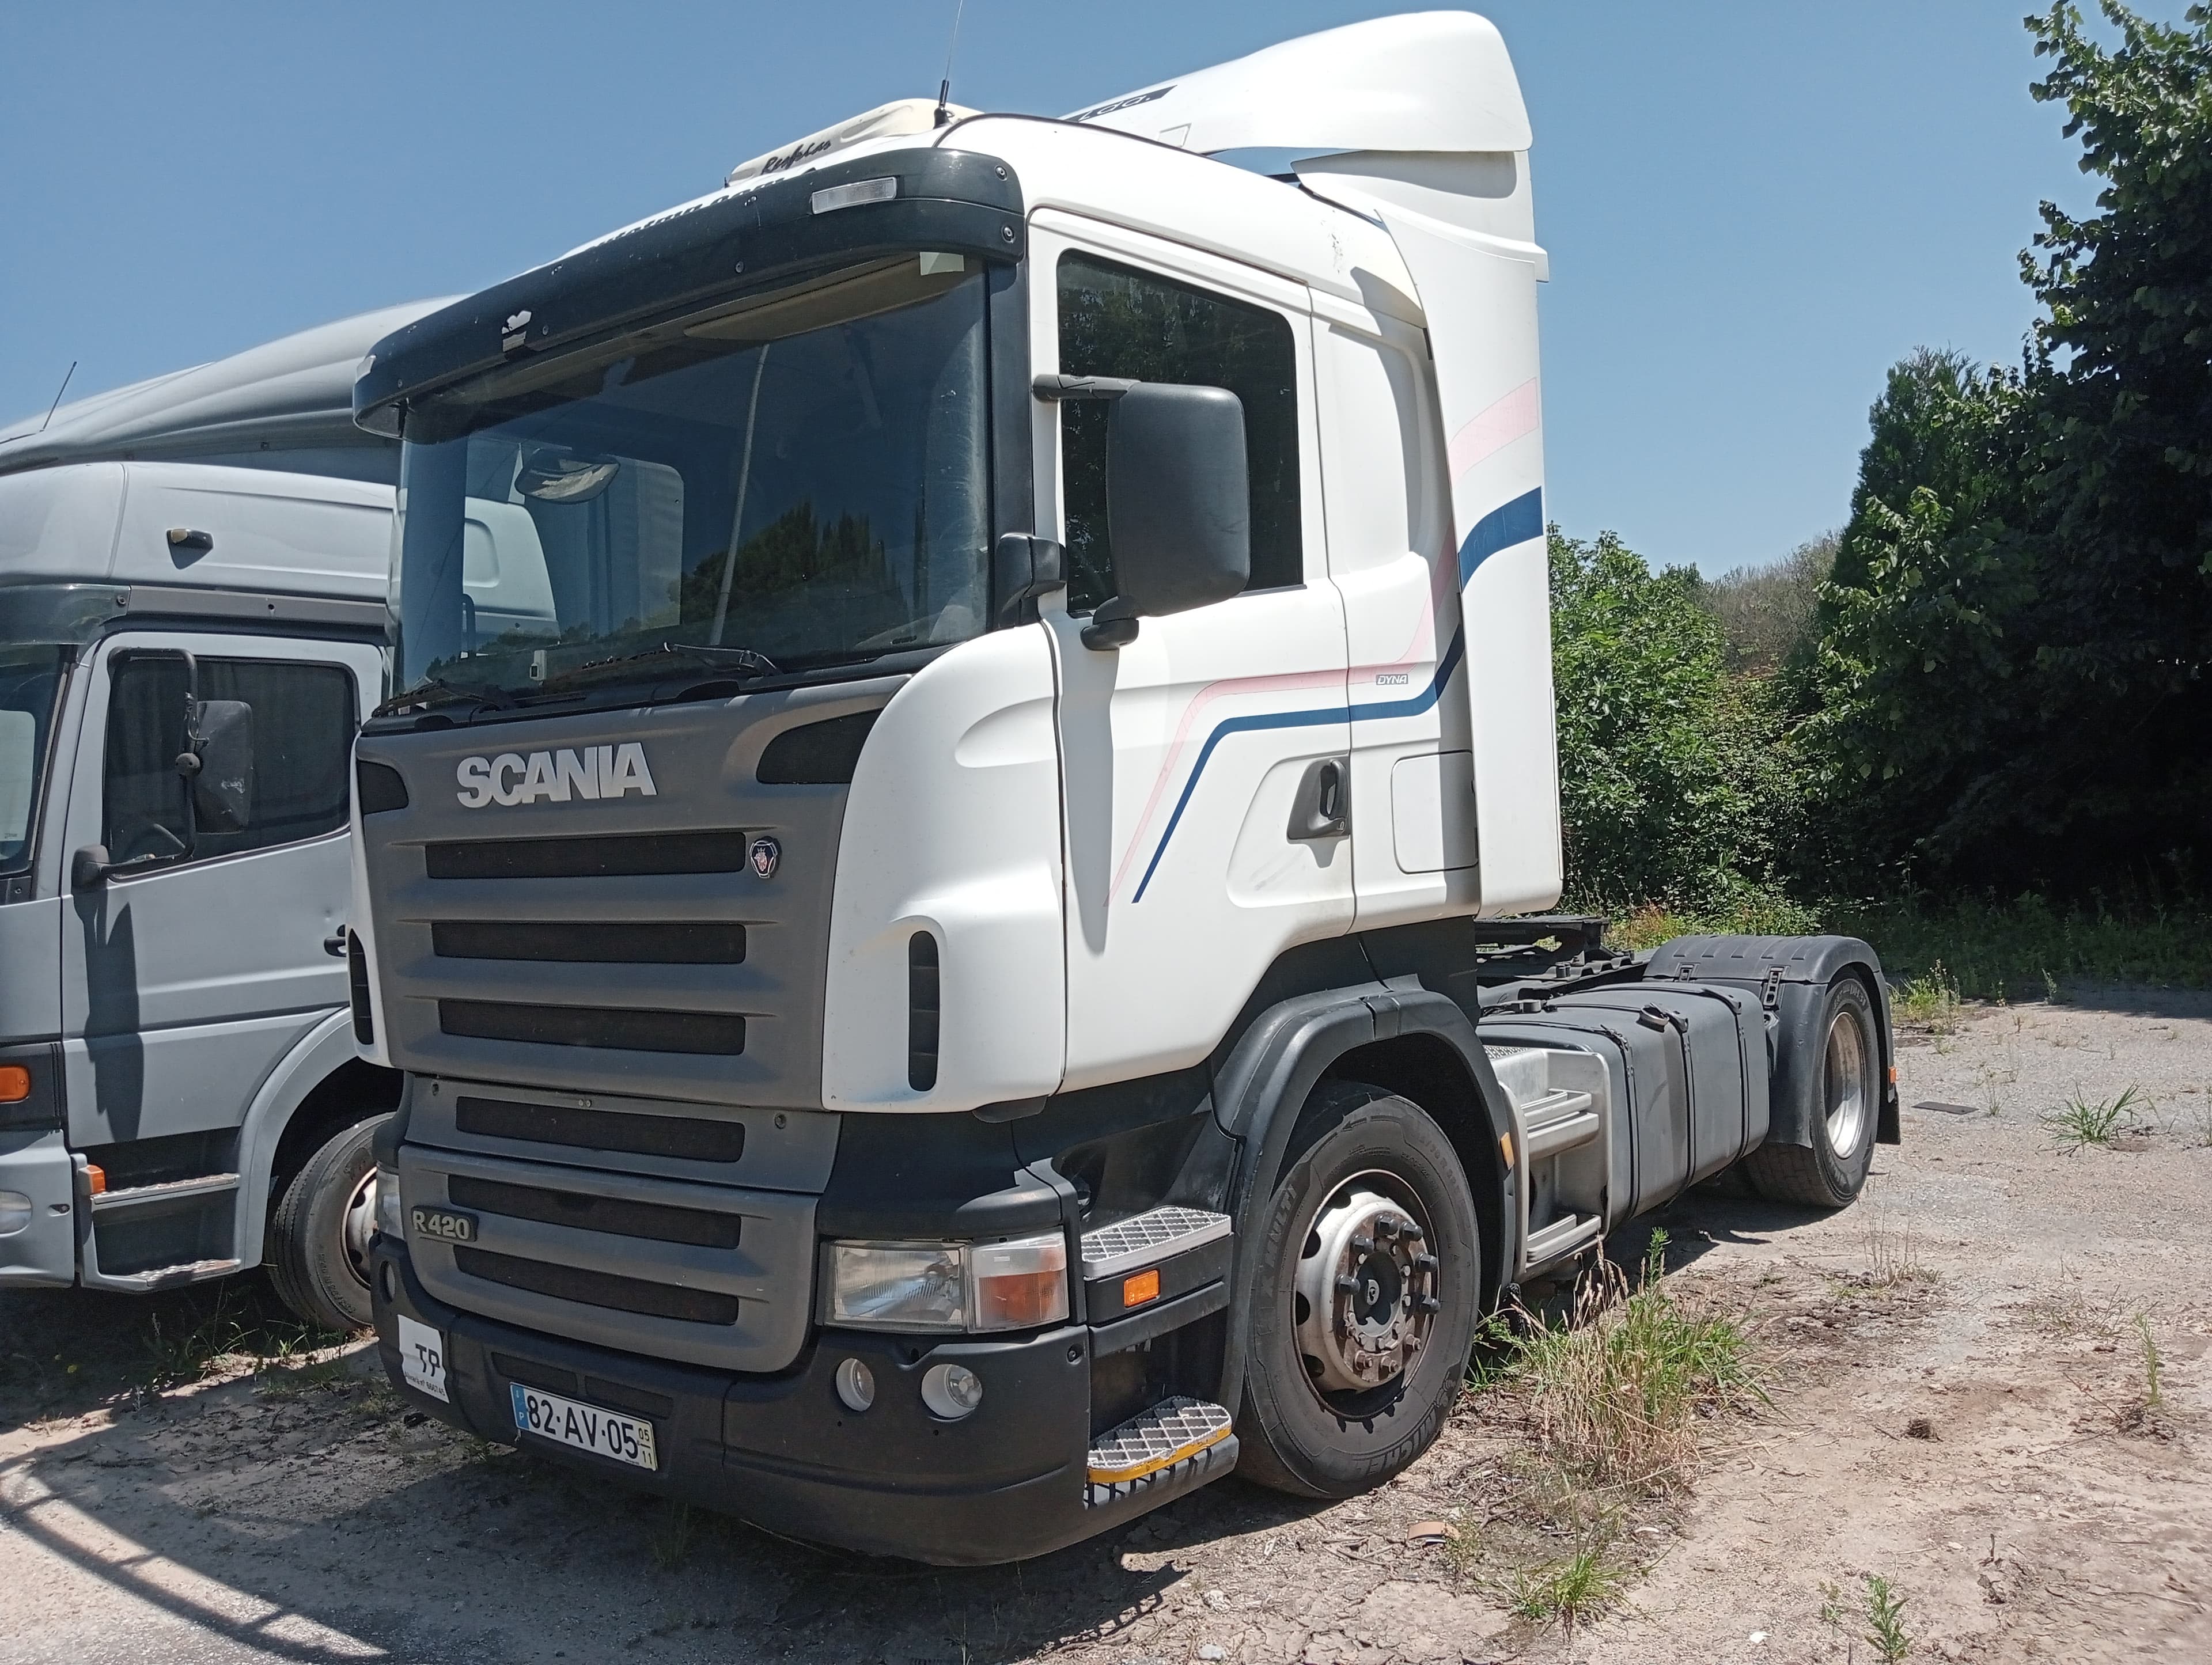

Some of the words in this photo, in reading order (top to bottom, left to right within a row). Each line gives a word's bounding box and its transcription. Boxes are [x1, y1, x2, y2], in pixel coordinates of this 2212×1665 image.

[1377, 674, 1407, 685] DYNA
[457, 742, 658, 809] SCANIA
[415, 1343, 440, 1377] TP
[519, 1412, 525, 1421] P
[638, 1428, 650, 1442] 05
[643, 1451, 652, 1465] 11
